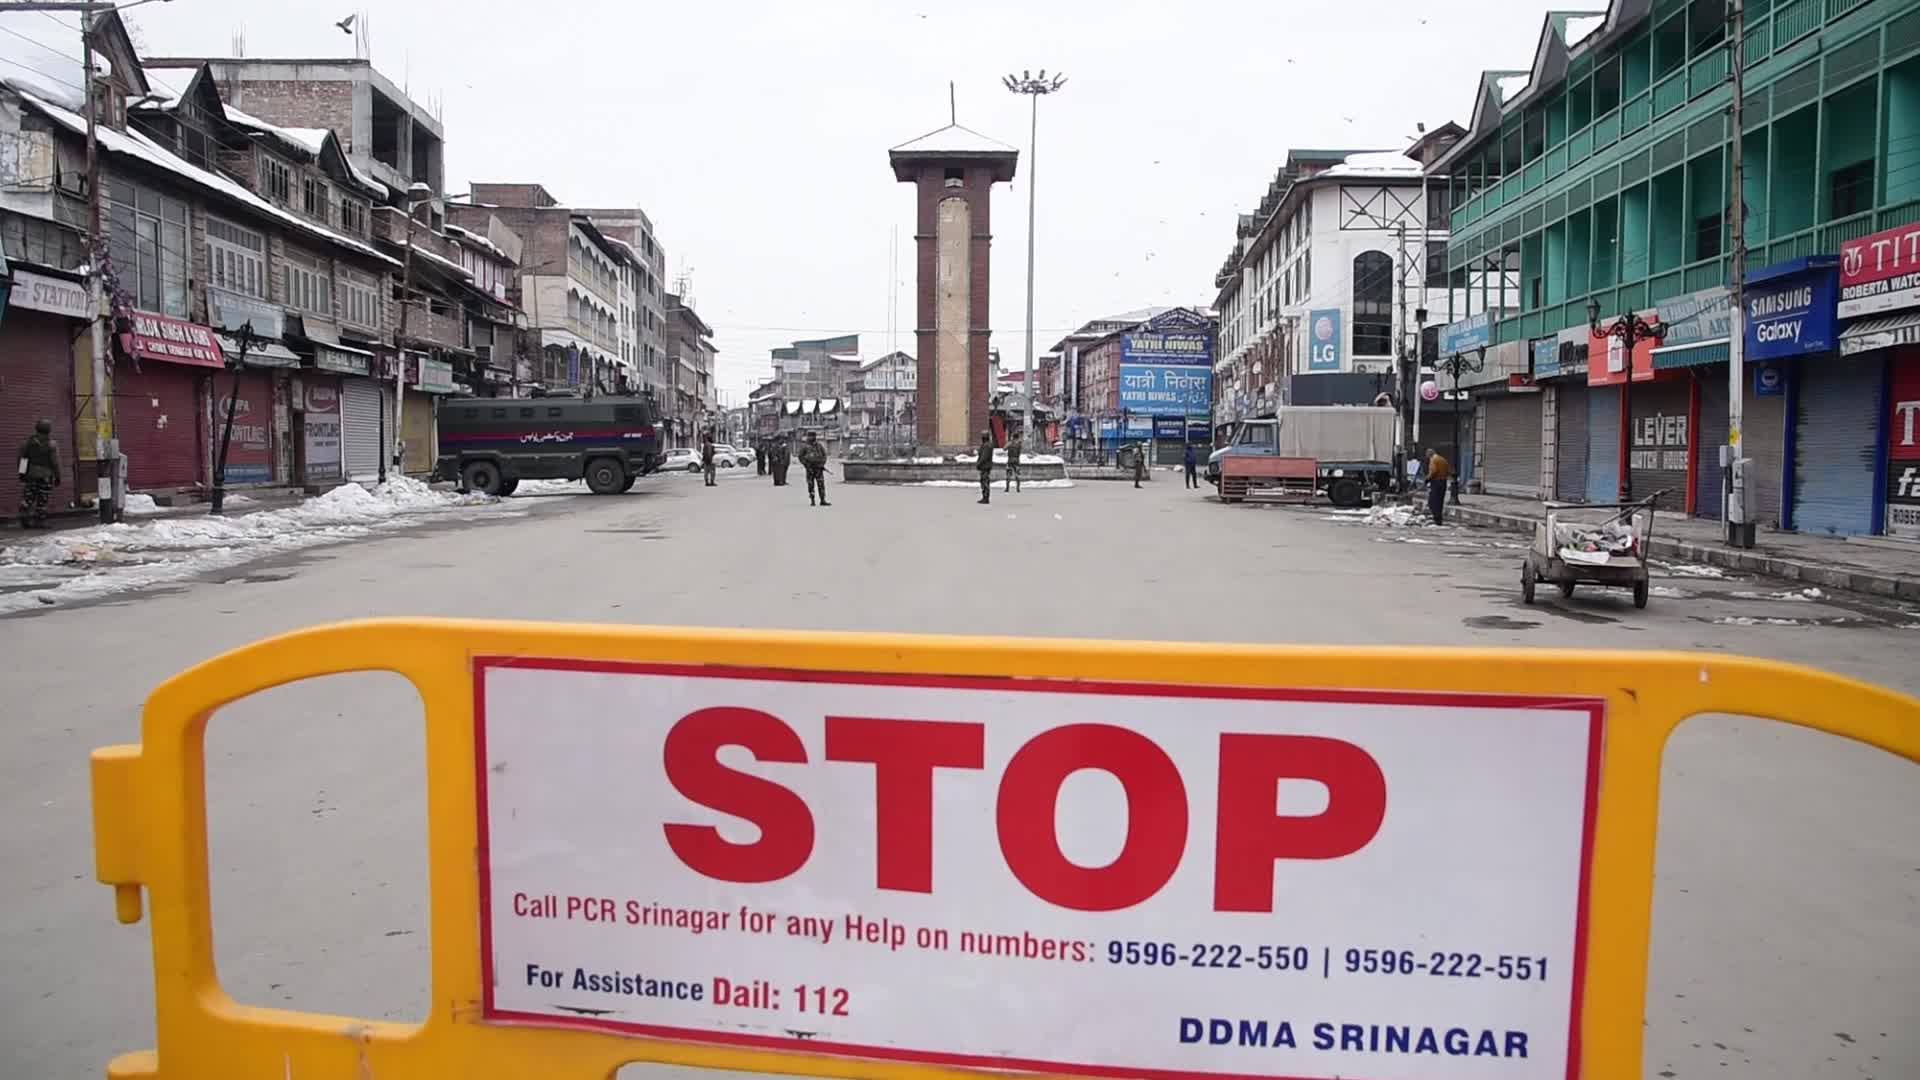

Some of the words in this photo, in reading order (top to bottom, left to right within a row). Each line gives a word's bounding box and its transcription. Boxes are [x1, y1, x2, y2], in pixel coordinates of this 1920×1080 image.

[1751, 287, 1812, 318] SAMSUNG
[1842, 279, 1889, 300] ROBERTA
[1164, 340, 1204, 351] NIWAS
[1757, 320, 1802, 344] Galaxy
[1313, 344, 1335, 363] LG
[1634, 415, 1687, 445] LEVER
[664, 706, 1388, 914] STOP
[514, 892, 558, 918] Call
[567, 896, 616, 923] PCR
[626, 900, 731, 935] Srinagar
[739, 907, 776, 936] for
[787, 914, 834, 944] any
[846, 915, 906, 950] Help
[918, 930, 949, 950] on
[960, 932, 1096, 963] numbers:
[1107, 940, 1310, 971] 9596-222-550
[1344, 949, 1549, 981] 9596-222-551
[526, 964, 564, 989] For
[572, 967, 704, 1001] Assistance
[712, 976, 781, 1012] Dail:
[793, 984, 850, 1017] 112
[1179, 1017, 1297, 1050] DDMA
[1312, 1023, 1530, 1058] SRINAGAR
